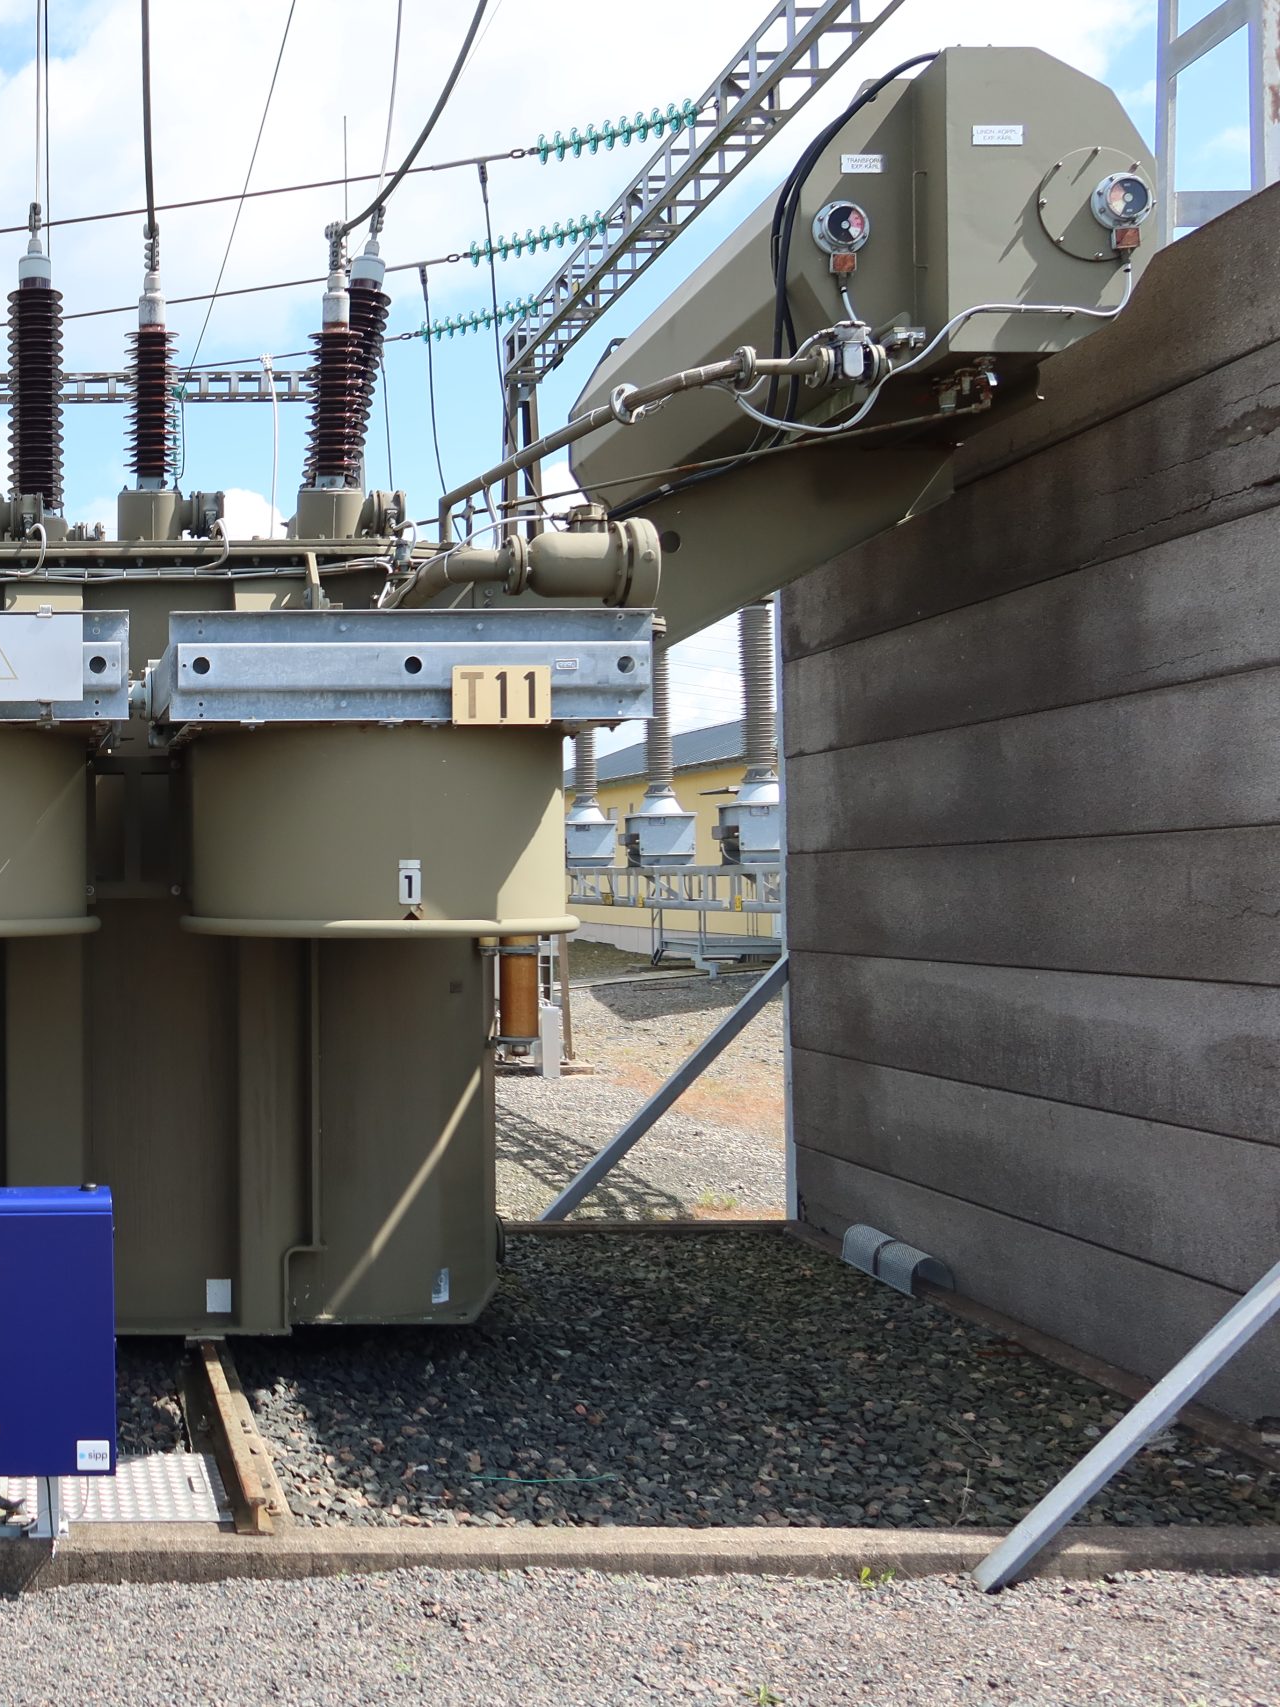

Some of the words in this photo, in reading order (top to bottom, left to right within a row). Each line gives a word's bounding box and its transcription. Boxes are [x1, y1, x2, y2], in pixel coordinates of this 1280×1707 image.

[460, 671, 536, 719] T11
[404, 875, 413, 898] 1
[88, 1450, 108, 1461] sipp
